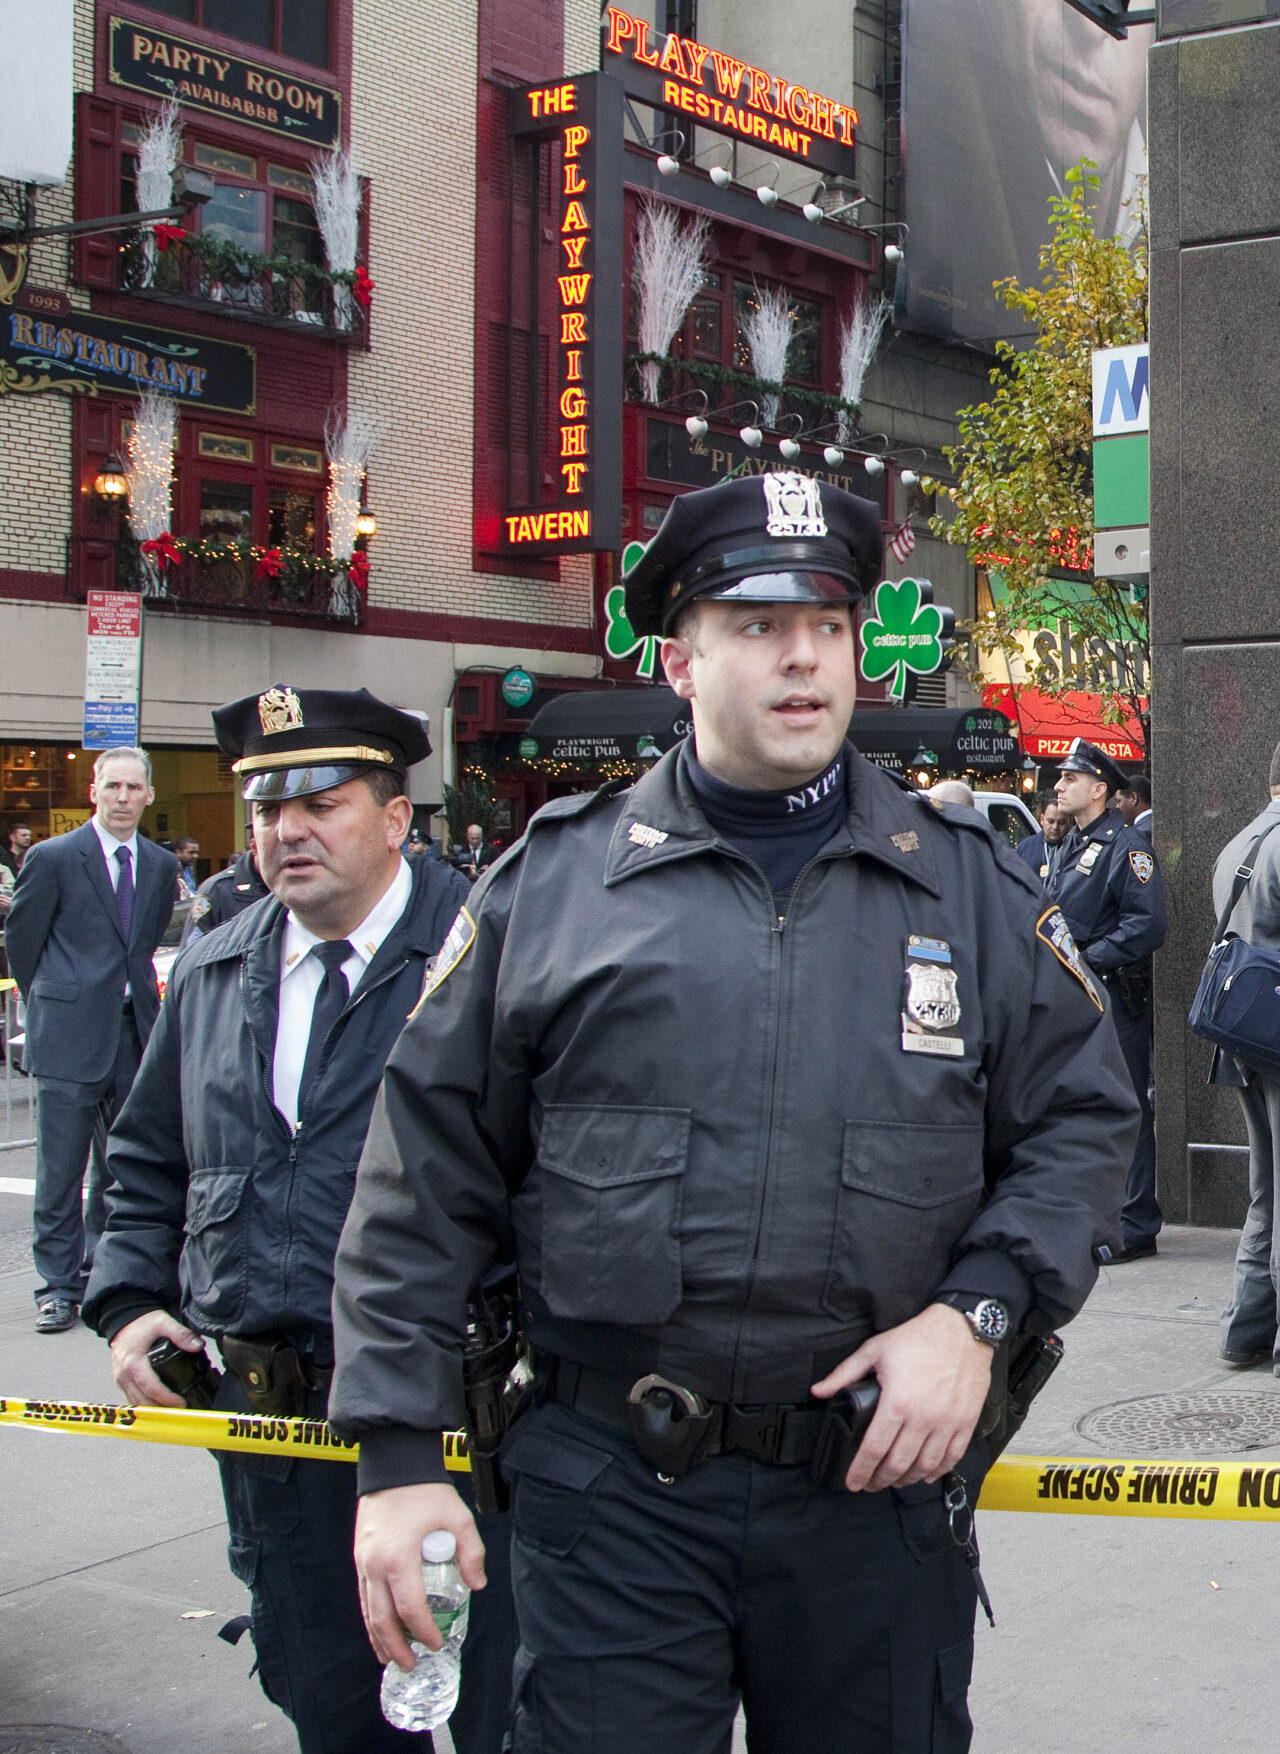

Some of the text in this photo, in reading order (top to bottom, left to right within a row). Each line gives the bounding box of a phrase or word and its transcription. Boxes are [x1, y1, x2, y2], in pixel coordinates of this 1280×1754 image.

[132, 33, 324, 120] PARTY ROOM
[606, 7, 858, 146] PLAYWRIGHT
[528, 83, 577, 117] THE
[663, 80, 812, 156] RESTAURANT
[29, 293, 61, 311] 1993
[557, 125, 592, 494] PLAYWRIGHT
[9, 313, 208, 396] RESTAURANT
[711, 449, 853, 493] PLAYWGHT
[506, 510, 590, 543] TAVERN
[105, 595, 138, 603] STANDING
[977, 719, 992, 730] 202
[1038, 740, 1070, 755] PIZZ
[1036, 1463, 1126, 1504] SCENE
[1127, 1466, 1219, 1507] CRIME
